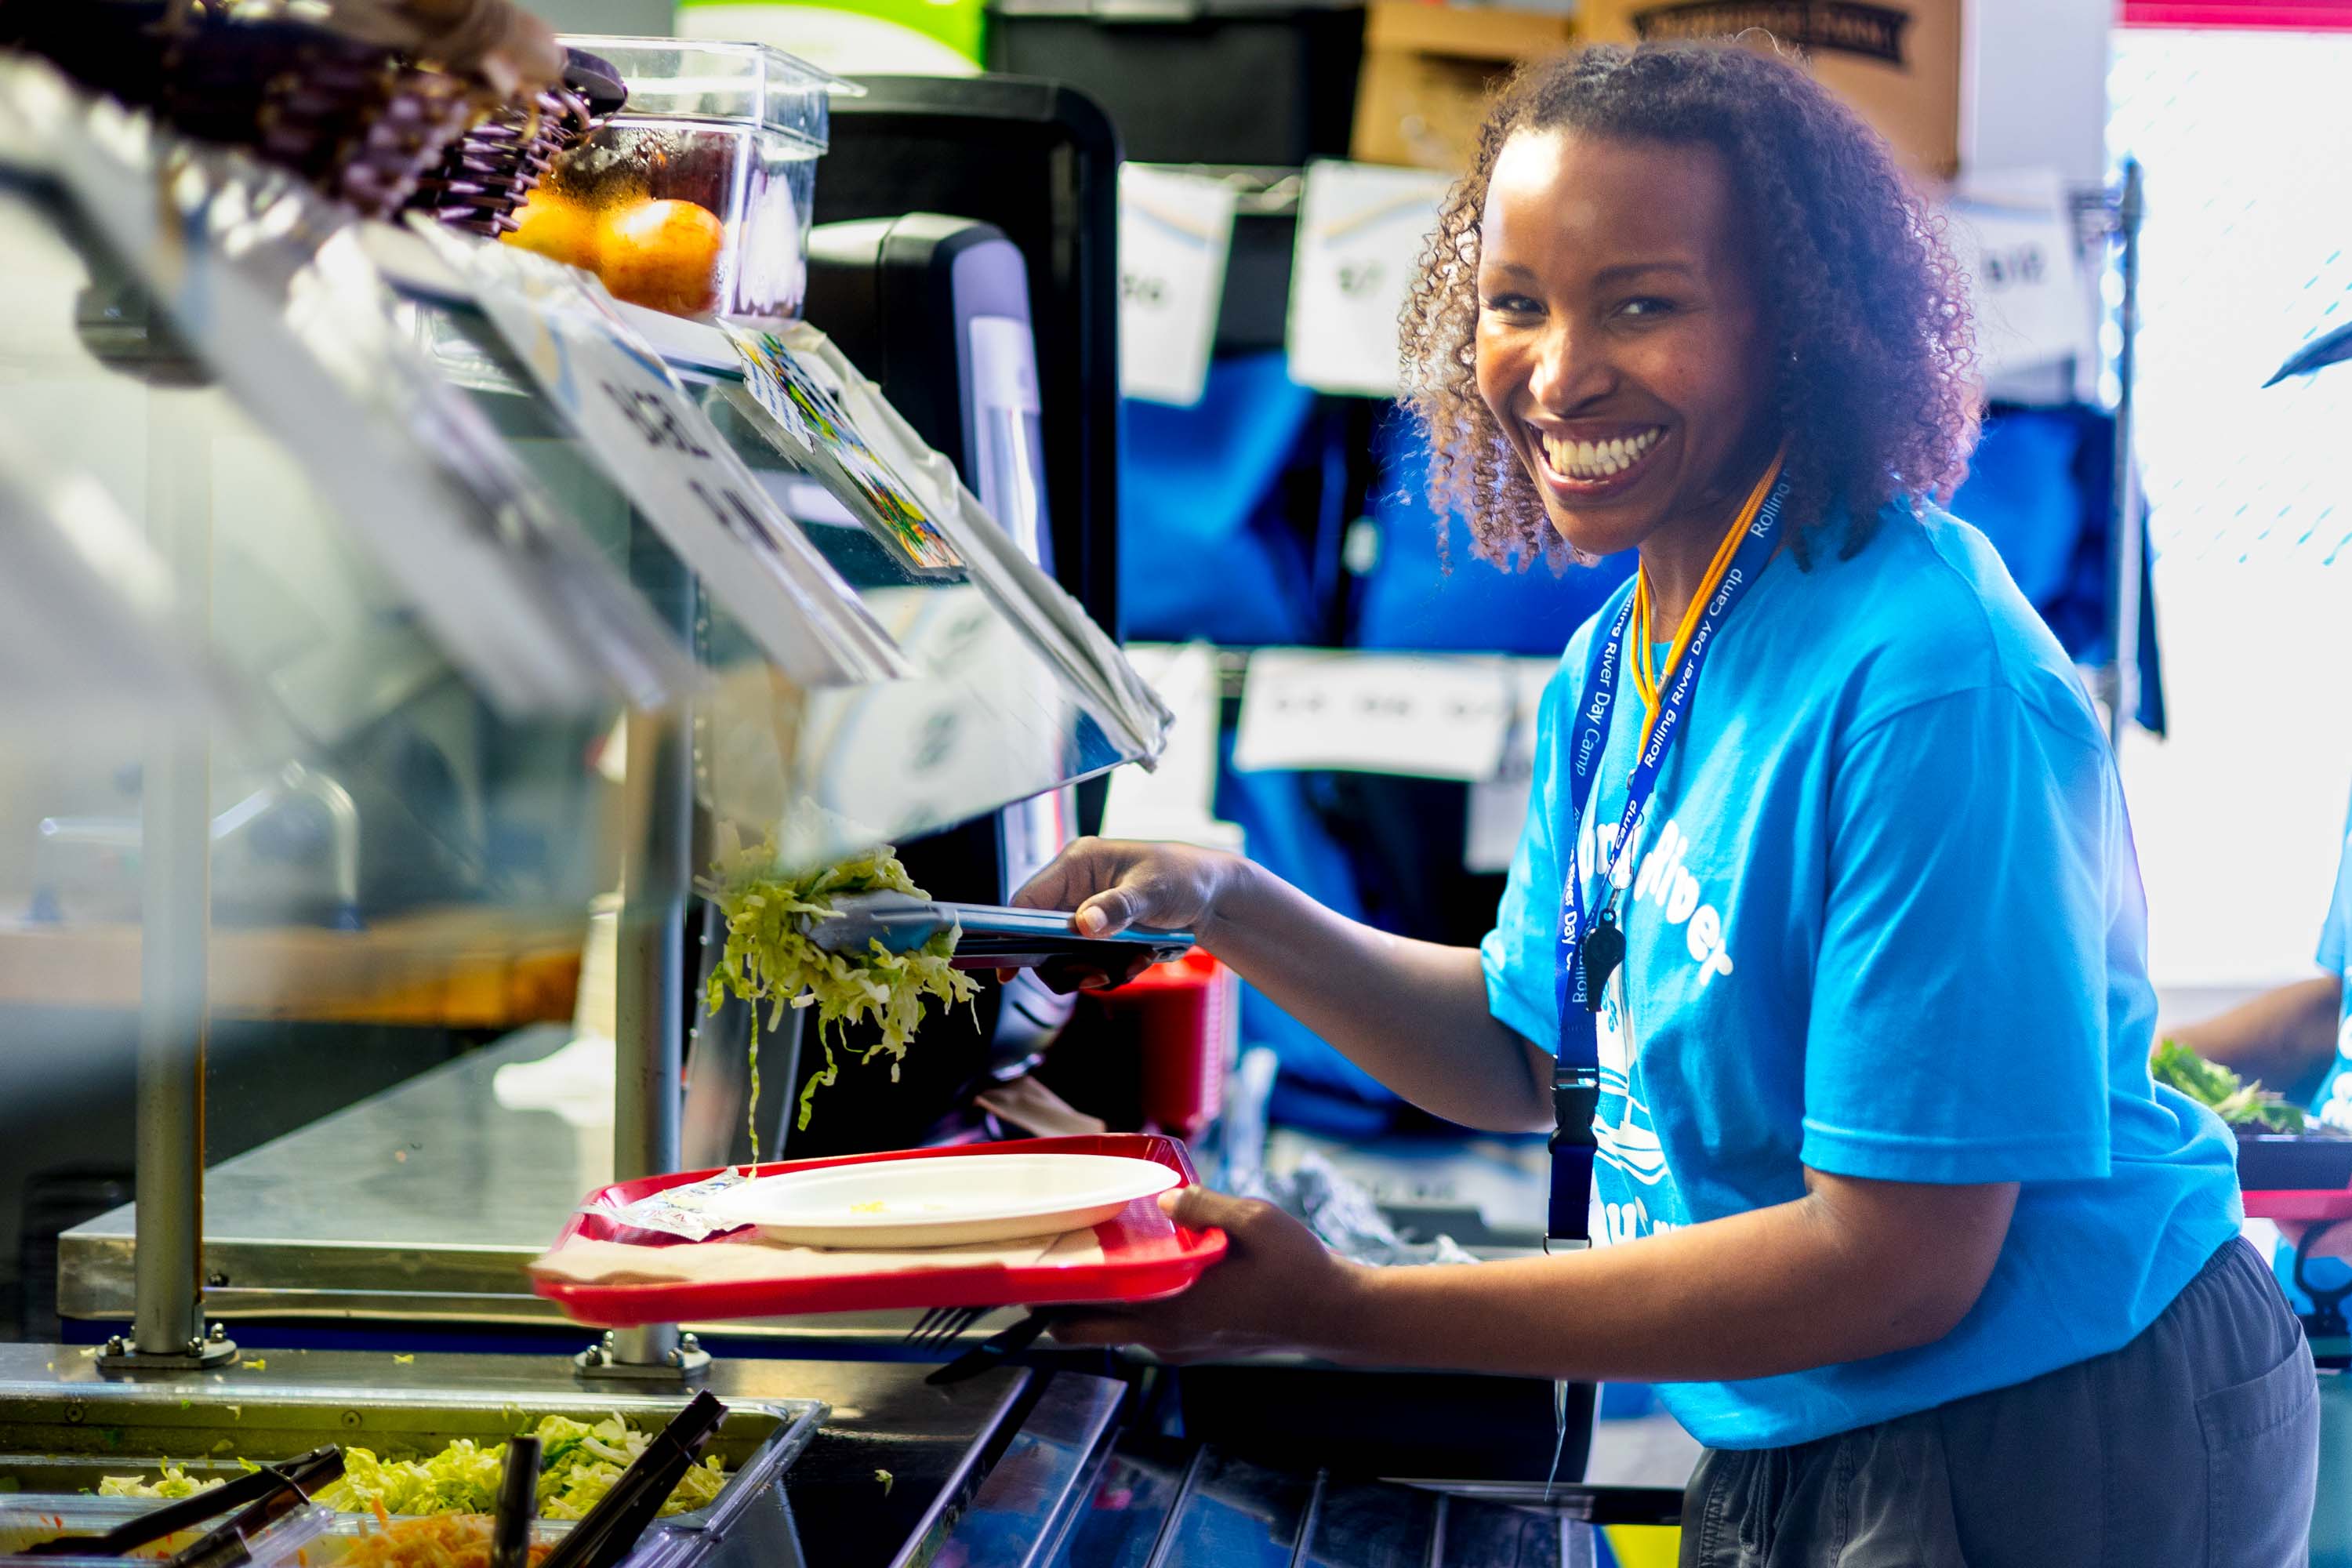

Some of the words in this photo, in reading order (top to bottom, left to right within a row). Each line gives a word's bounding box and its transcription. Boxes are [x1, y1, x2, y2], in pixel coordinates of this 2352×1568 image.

[1600, 641, 1617, 688] River
[1644, 709, 1677, 768] Rolling
[1671, 658, 1694, 706] River
[1691, 619, 1712, 656] Day
[1709, 568, 1743, 617] Camp
[1586, 691, 1611, 726] Day
[1575, 728, 1601, 778] Camp
[1561, 910, 1578, 946] Day
